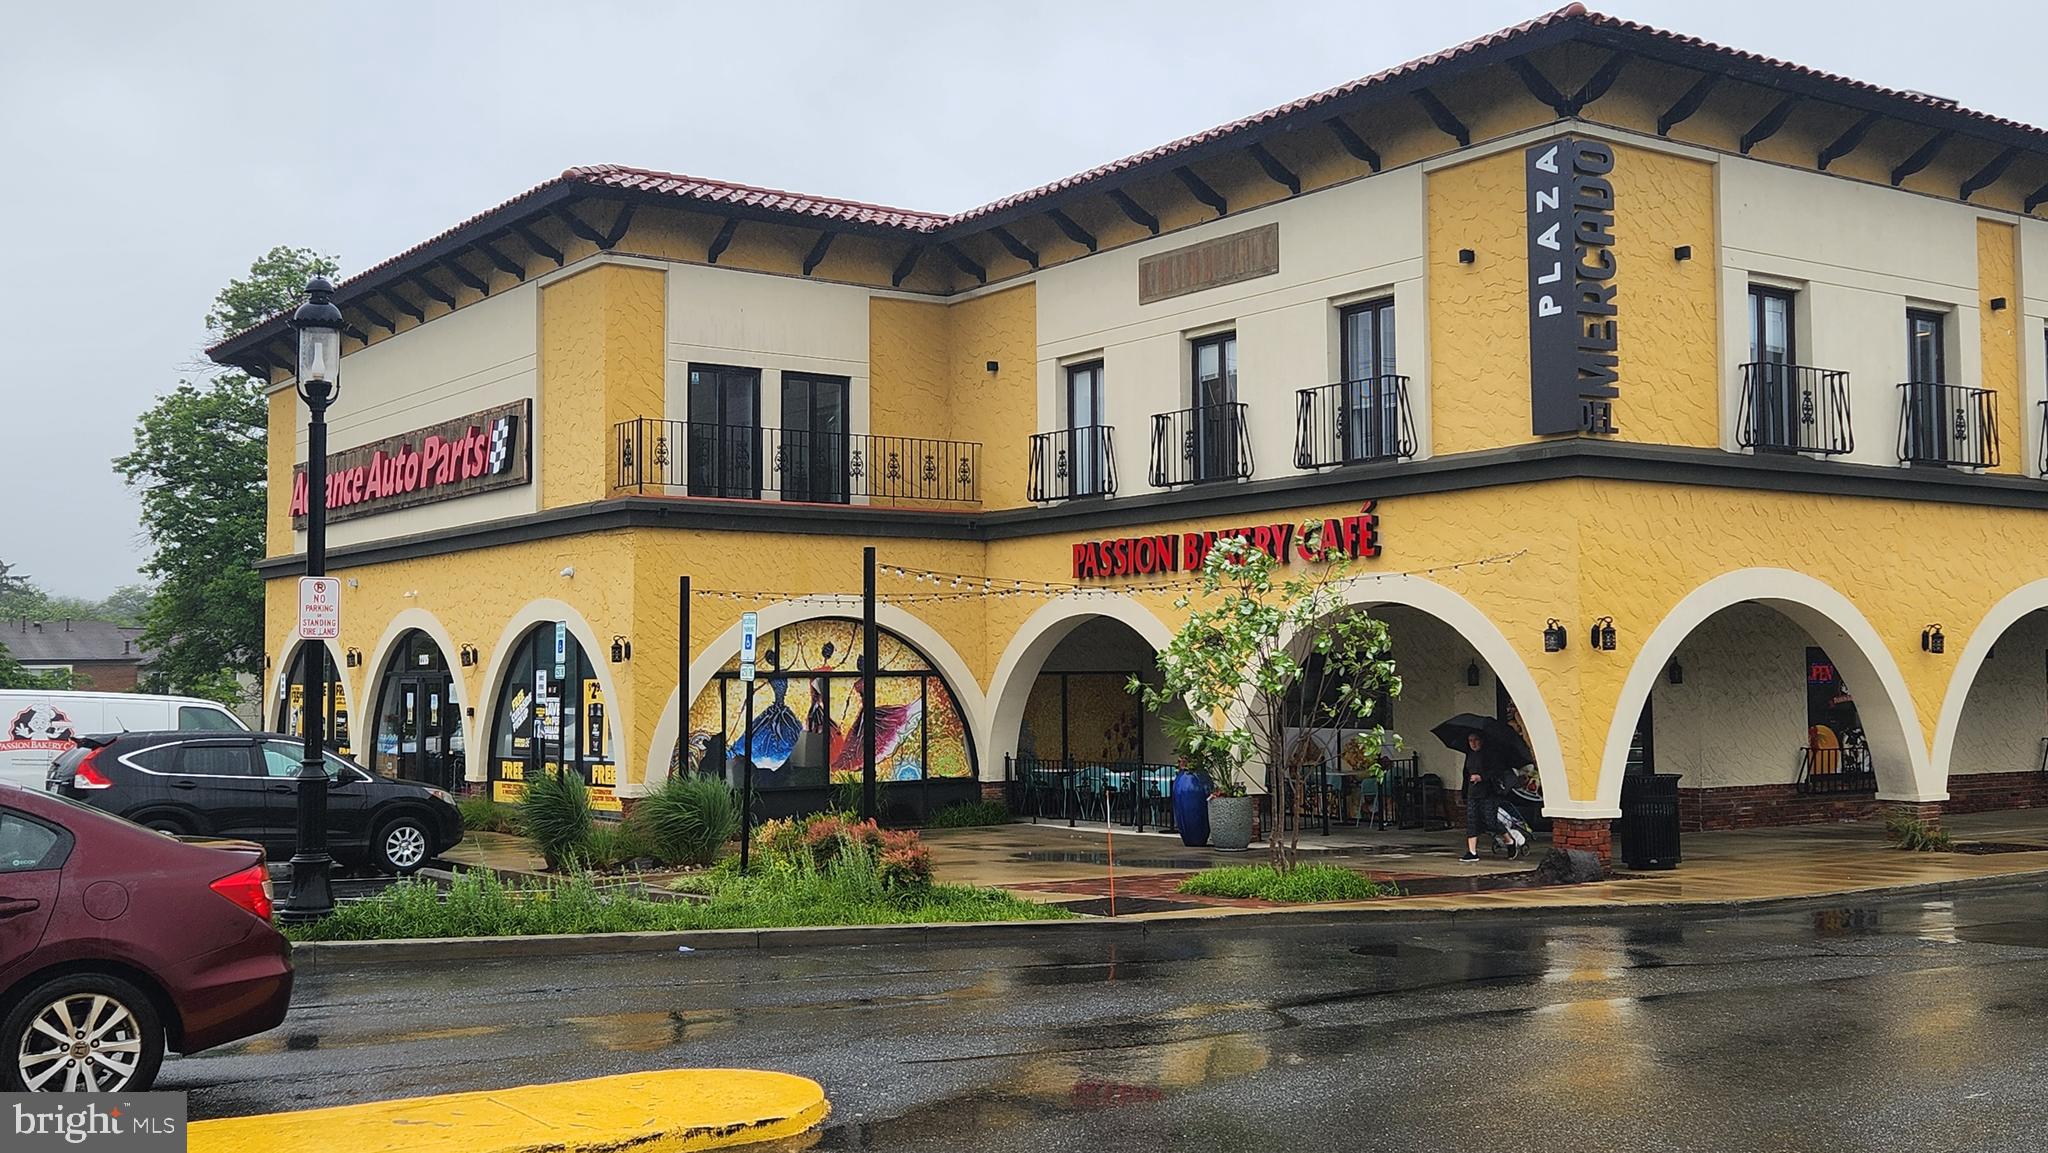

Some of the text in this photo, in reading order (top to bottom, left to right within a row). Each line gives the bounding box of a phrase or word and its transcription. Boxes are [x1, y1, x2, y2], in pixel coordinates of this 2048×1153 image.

[1535, 145, 1563, 318] PLAZA
[1573, 140, 1620, 434] DEL MERCADO
[289, 426, 488, 517] Aance Auto Parts
[1072, 534, 1179, 579] PASSION
[1296, 500, 1382, 562] CAFÉ
[305, 604, 334, 612] PARKING
[313, 594, 326, 603] NO
[303, 627, 316, 635] FIRE
[31, 740, 62, 749] BAKERY
[502, 760, 523, 780] FREE
[592, 765, 616, 784] FREE
